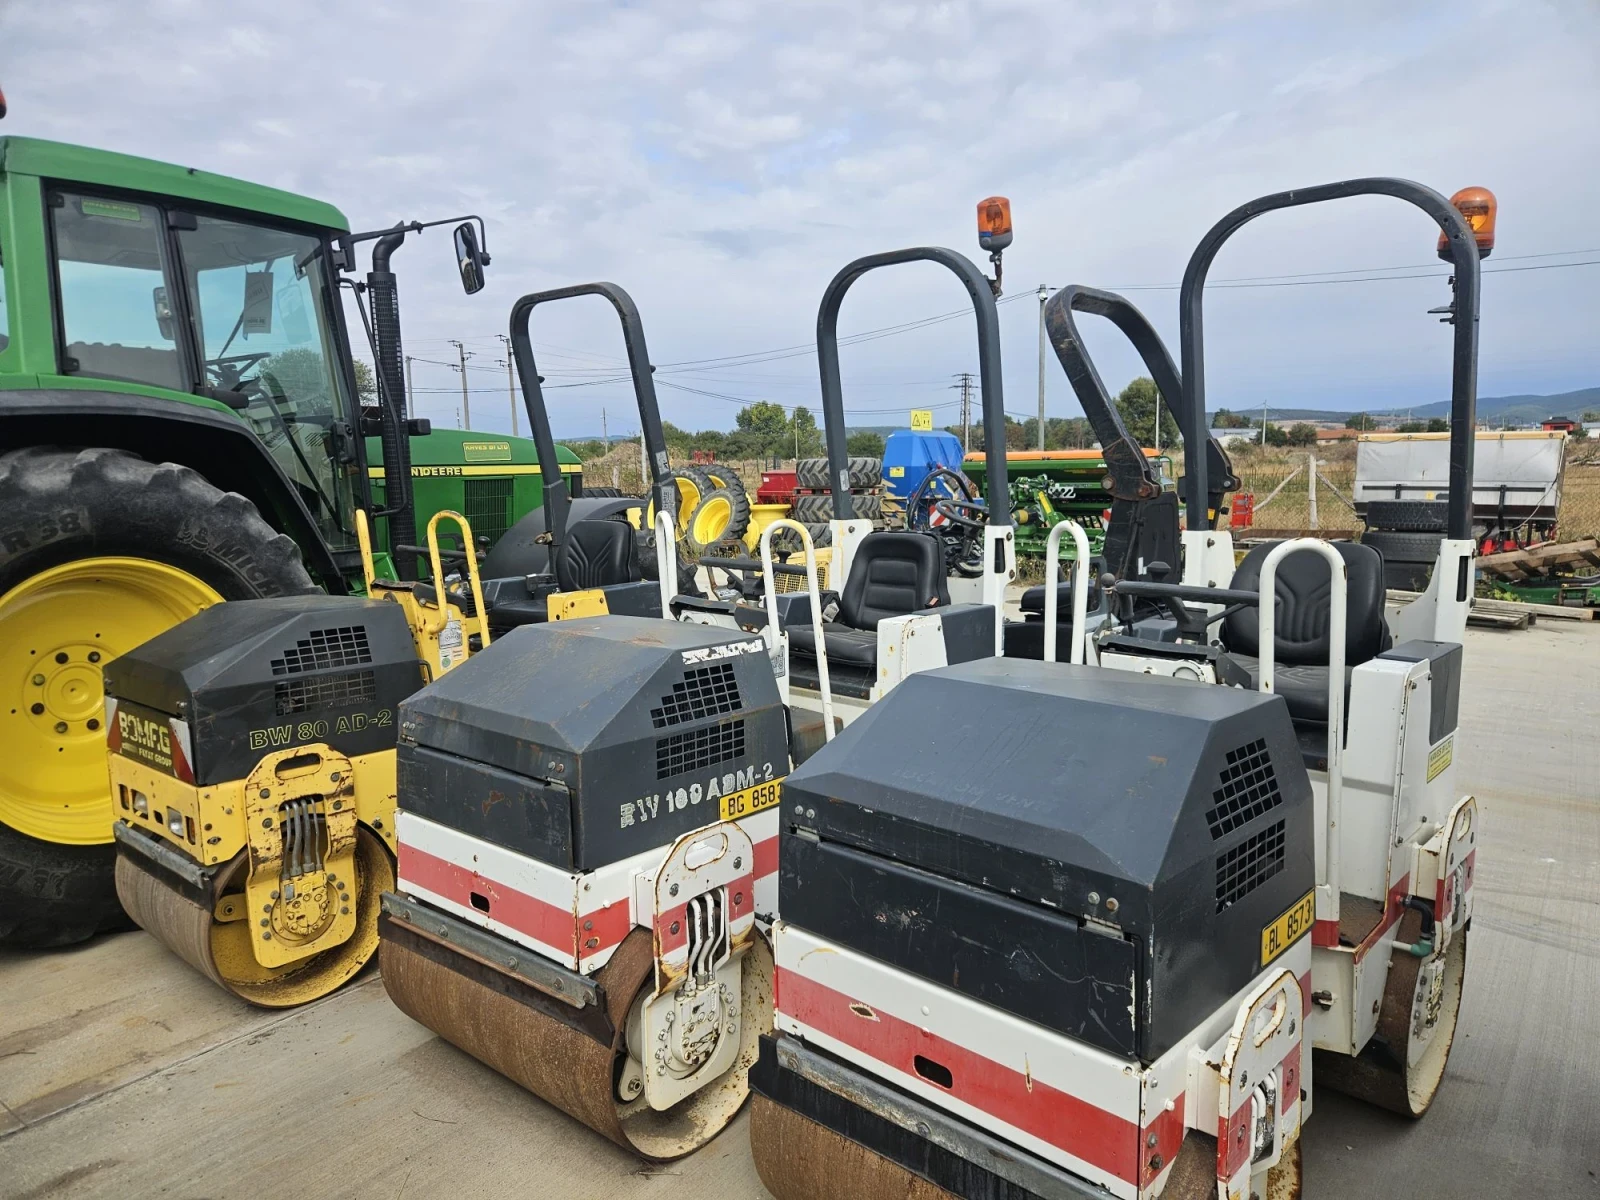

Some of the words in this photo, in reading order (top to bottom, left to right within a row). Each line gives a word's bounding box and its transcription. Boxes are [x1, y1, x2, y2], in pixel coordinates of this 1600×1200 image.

[423, 467, 461, 476] DEERE
[210, 540, 283, 599] MICH
[249, 725, 292, 750] BW
[298, 720, 329, 740] 80
[336, 709, 392, 735] AD-2
[728, 794, 745, 817] BG
[1269, 925, 1281, 956] BL
[1287, 899, 1311, 940] 8573
